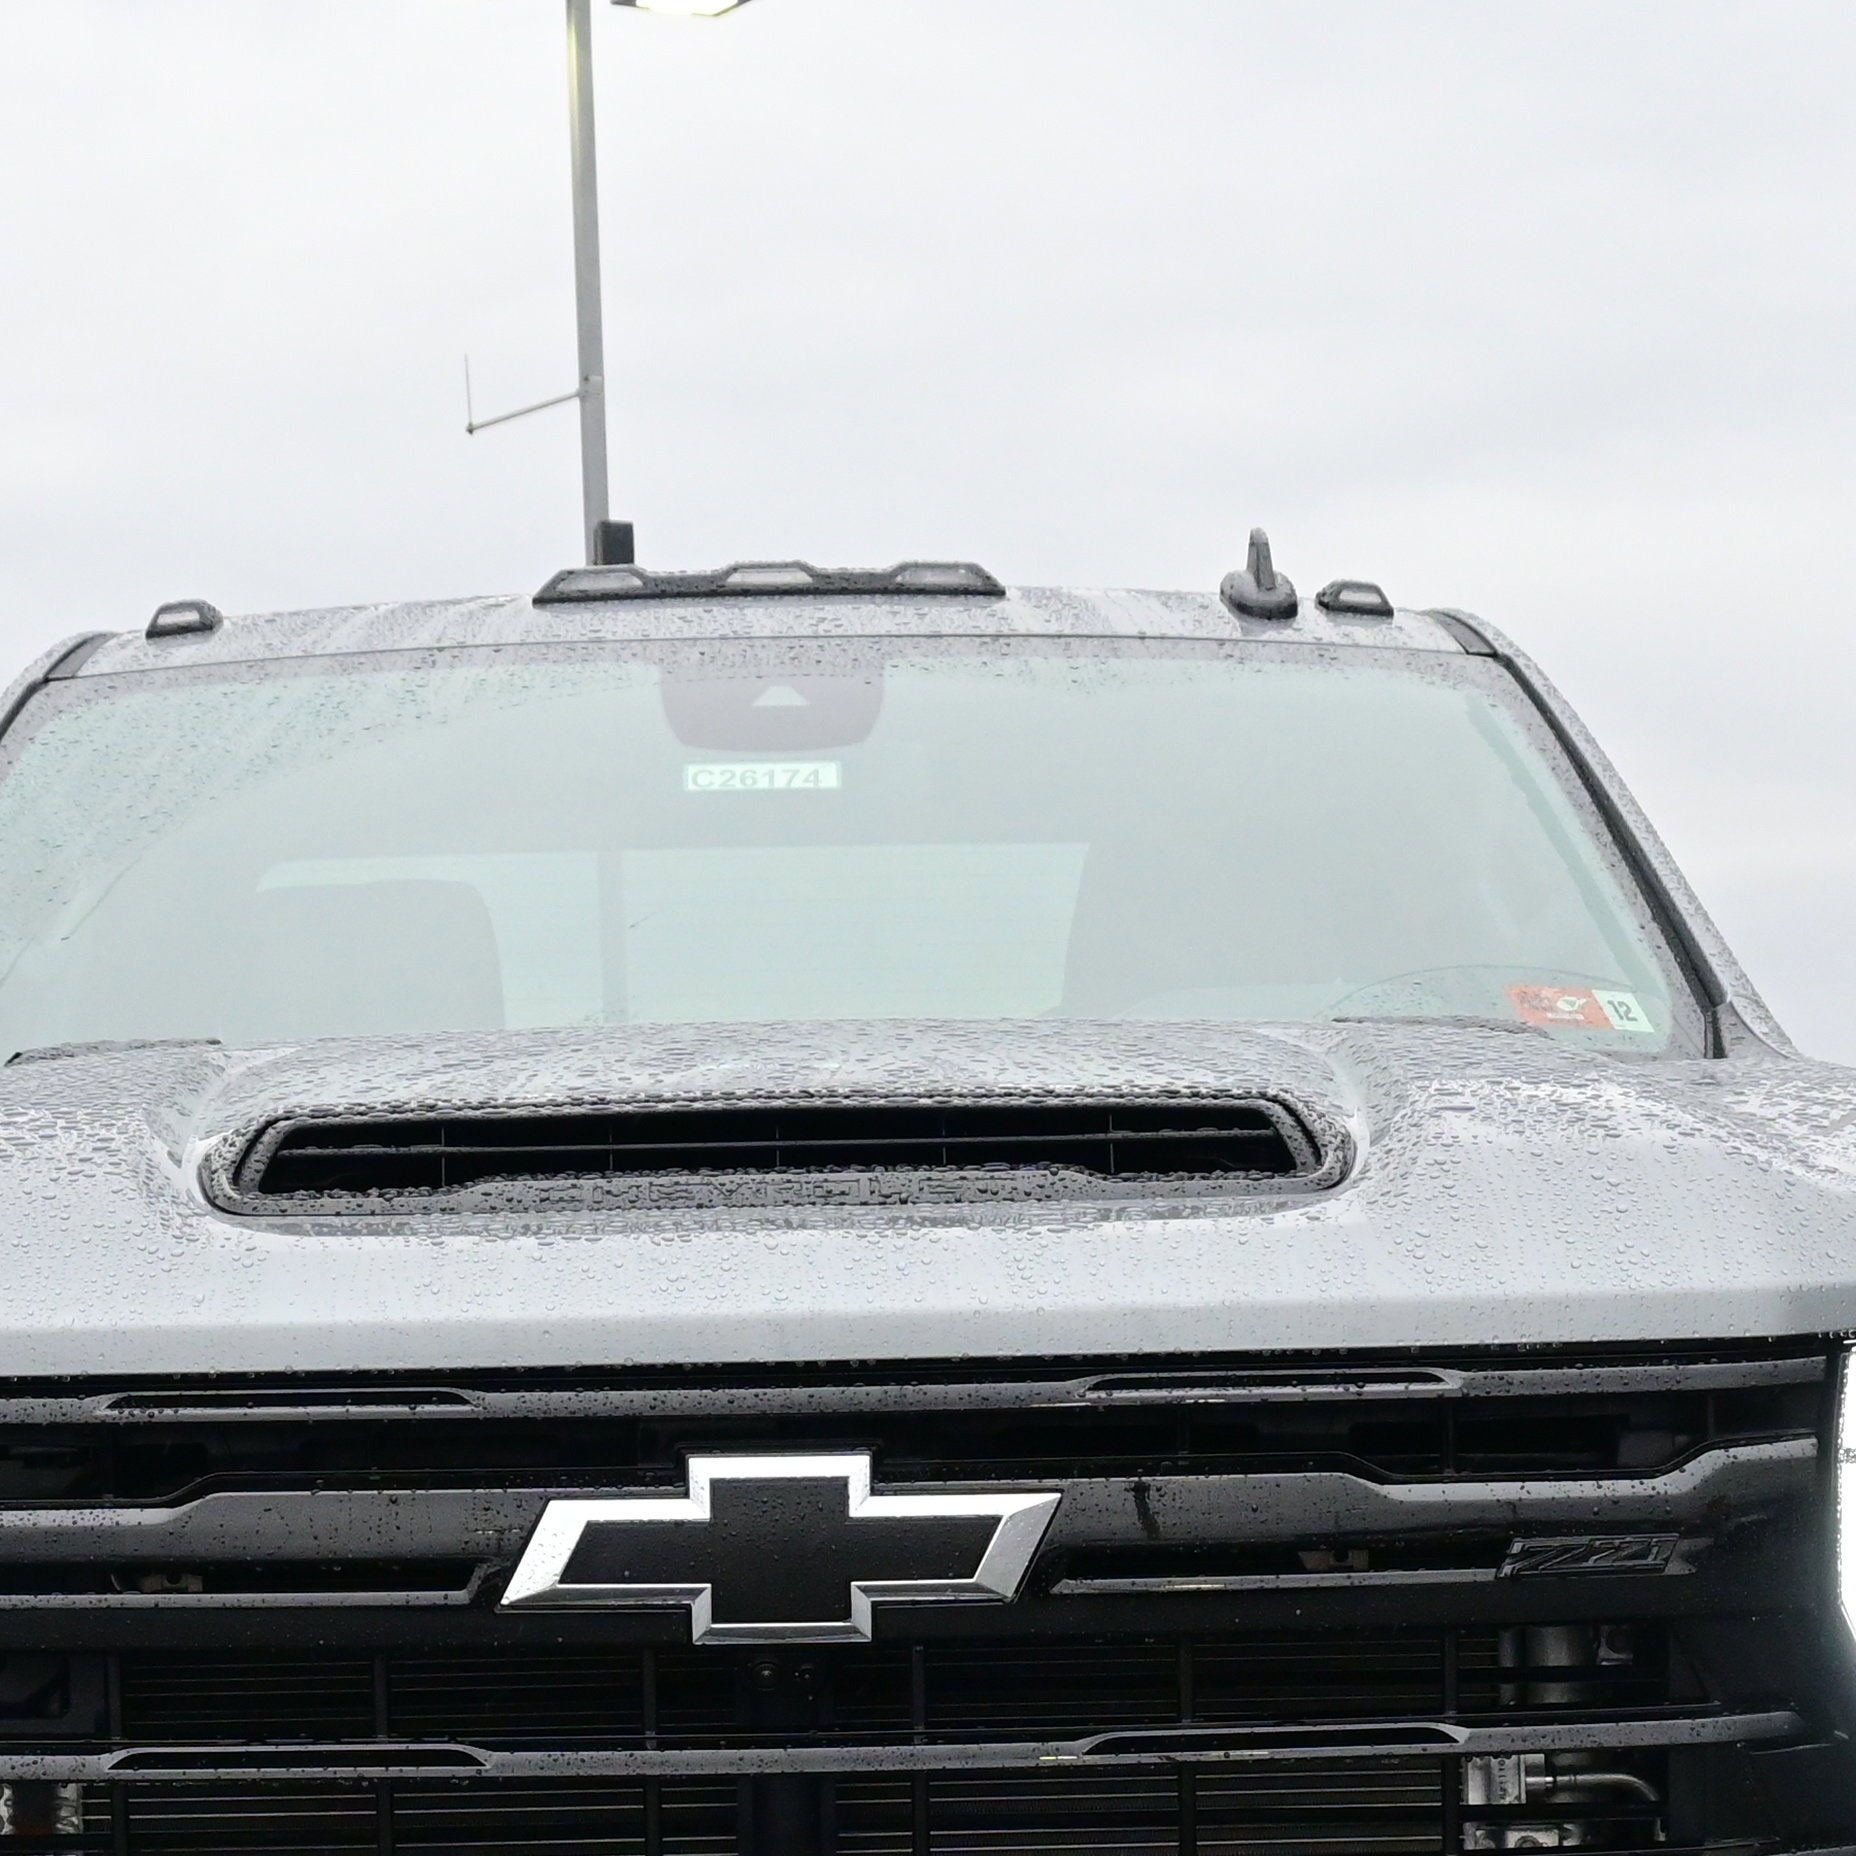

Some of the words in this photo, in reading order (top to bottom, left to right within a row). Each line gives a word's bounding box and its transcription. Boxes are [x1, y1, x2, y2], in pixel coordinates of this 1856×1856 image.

[691, 768, 823, 789] C26174
[1606, 999, 1638, 1022] 12
[1497, 1533, 1679, 1577] Z71
